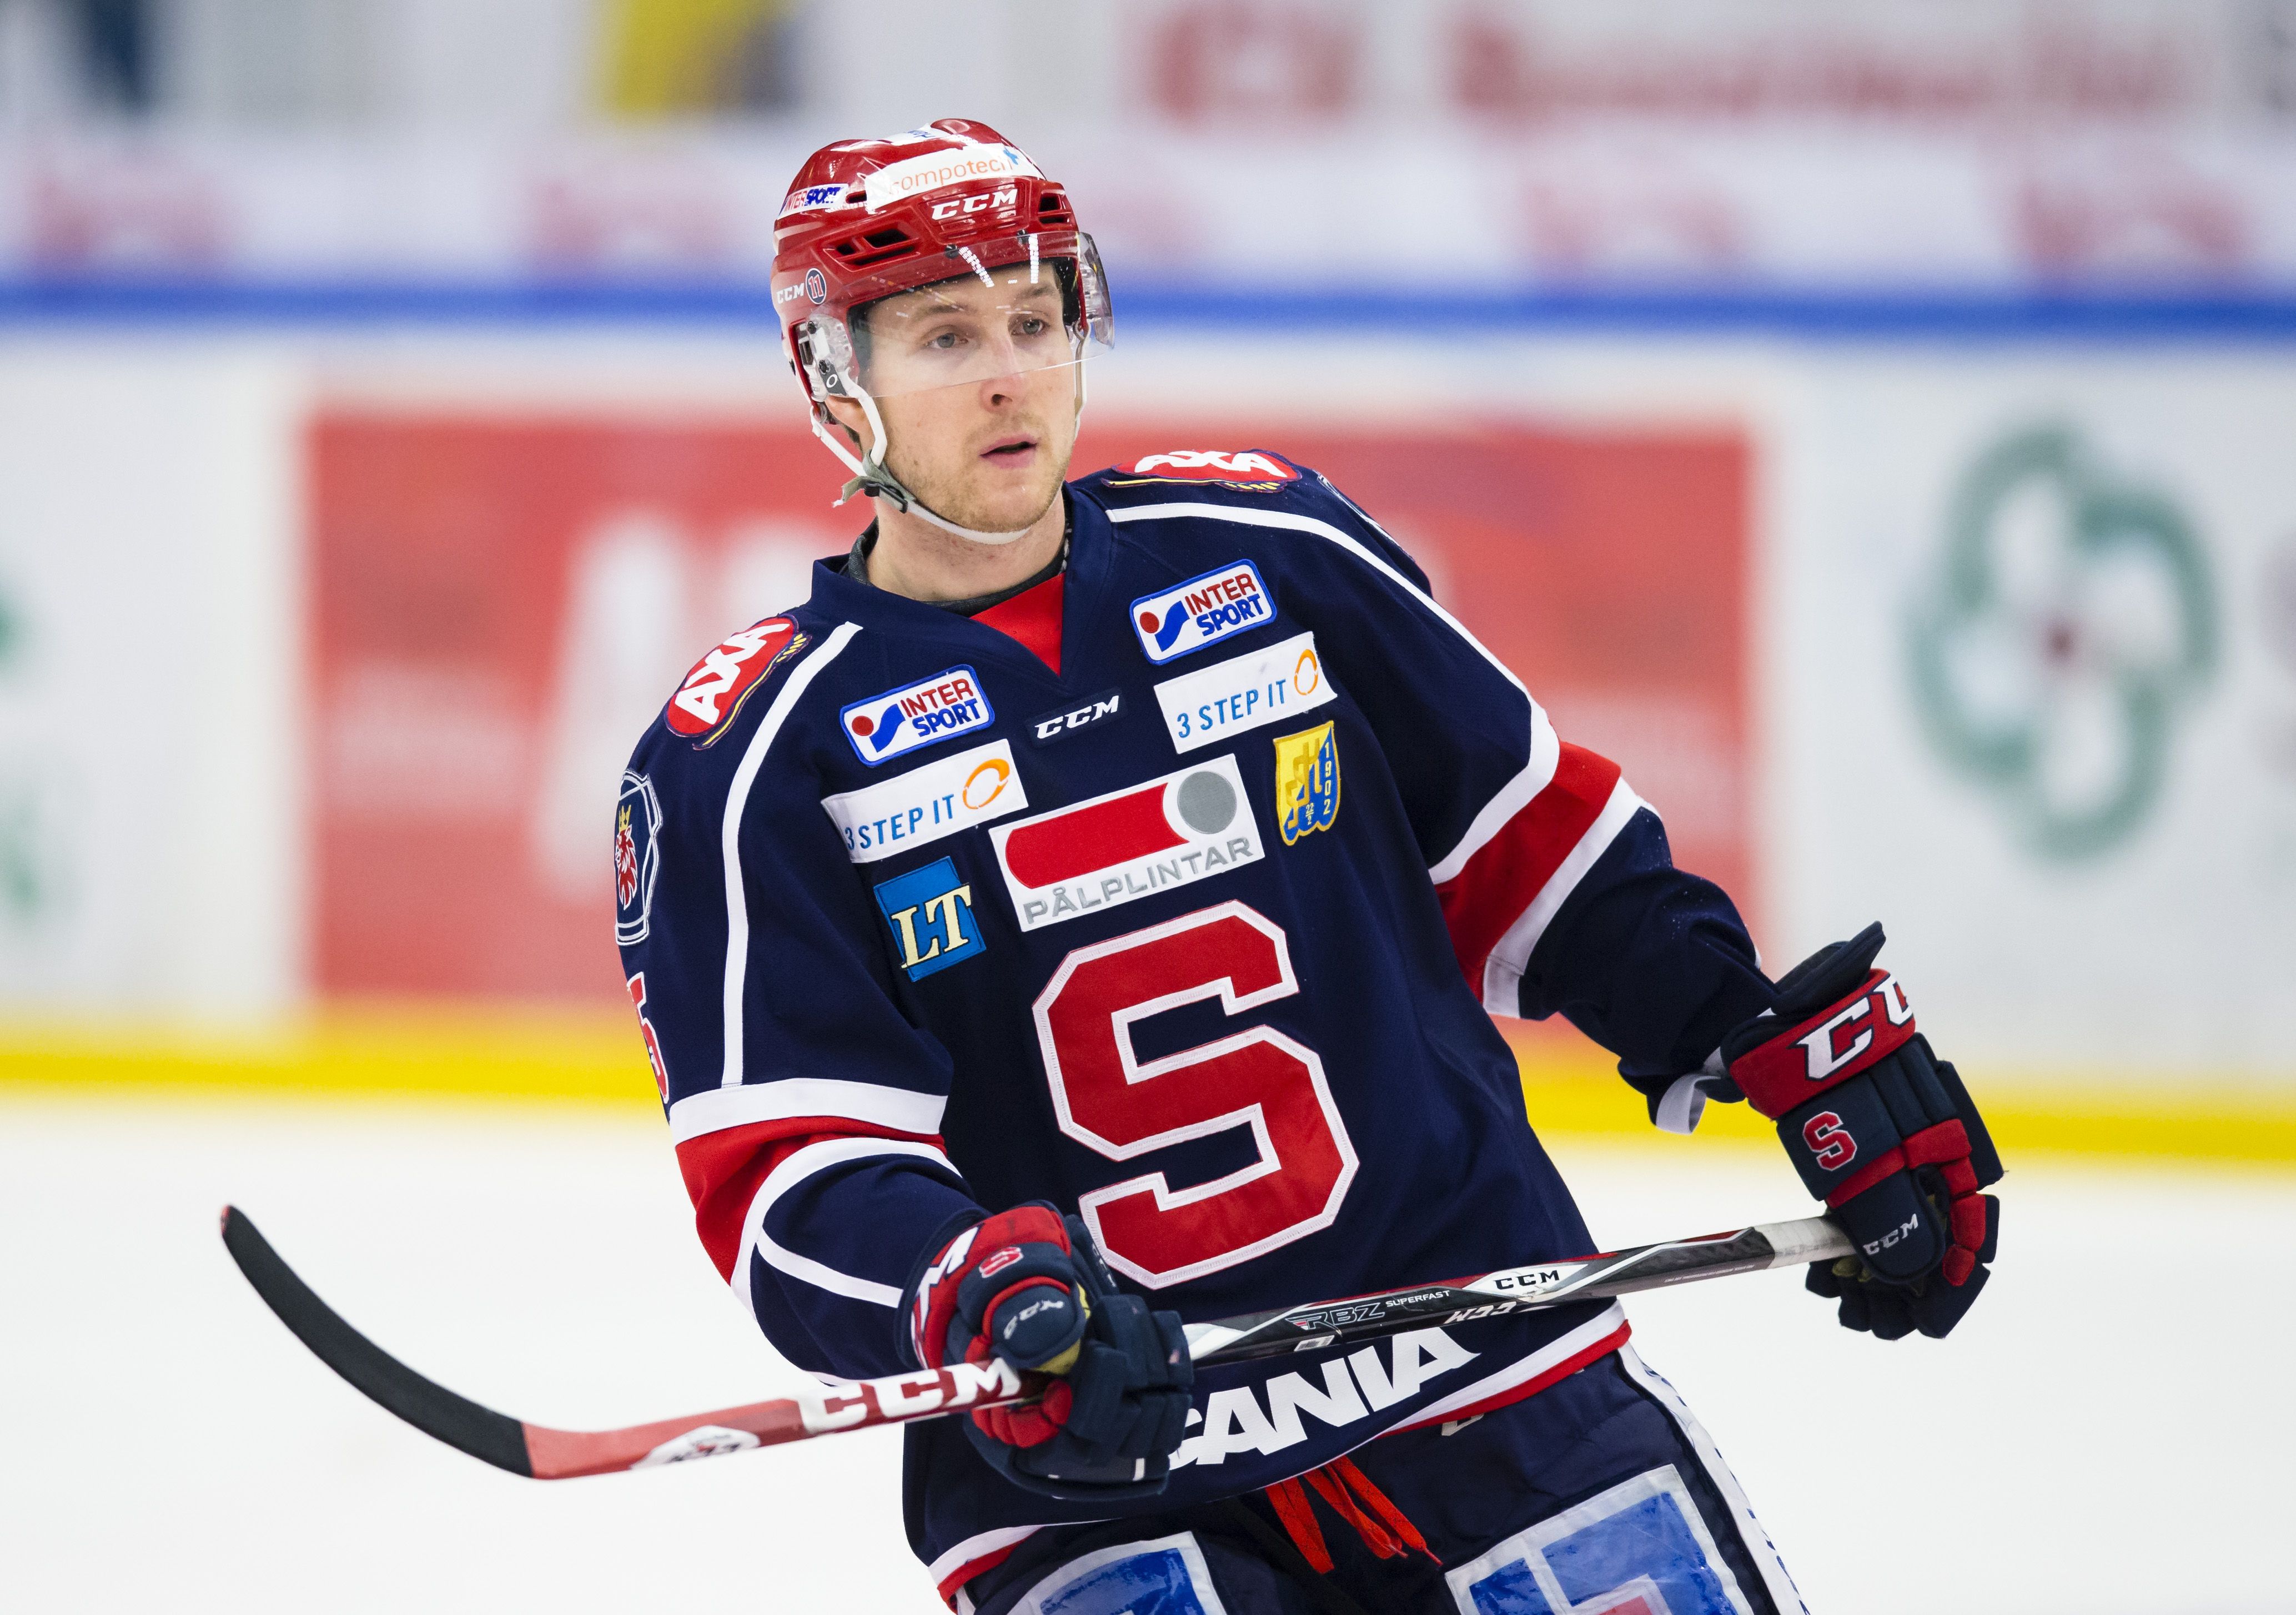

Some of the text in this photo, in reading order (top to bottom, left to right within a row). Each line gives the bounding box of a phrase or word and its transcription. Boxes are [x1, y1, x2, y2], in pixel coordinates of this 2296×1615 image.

[931, 189, 1017, 220] CCM
[776, 283, 805, 304] CCM
[808, 274, 824, 299] 11
[1134, 451, 1288, 477] AXA
[1185, 573, 1257, 615] INTER
[1196, 593, 1264, 636] SPORT
[675, 623, 790, 725] AXA
[900, 678, 974, 717] INTER
[912, 698, 981, 737] SPORT
[1035, 695, 1119, 739] CCM
[1177, 679, 1286, 738] 3 STEP IT
[1323, 742, 1332, 815] 1902
[845, 793, 954, 850] 3 STEP IT
[1023, 837, 1254, 924] PÅLPLINTAR
[890, 883, 973, 970] LT
[1795, 973, 1914, 1079] CC
[1032, 899, 1360, 1290] S
[1802, 1111, 1857, 1171] S
[1863, 1213, 1918, 1255] CCM
[1385, 1290, 1450, 1307] SUPERFAST
[1493, 1270, 1560, 1290] CCM
[798, 1357, 1021, 1433] CCM
[1168, 1327, 1481, 1471] CANIA
